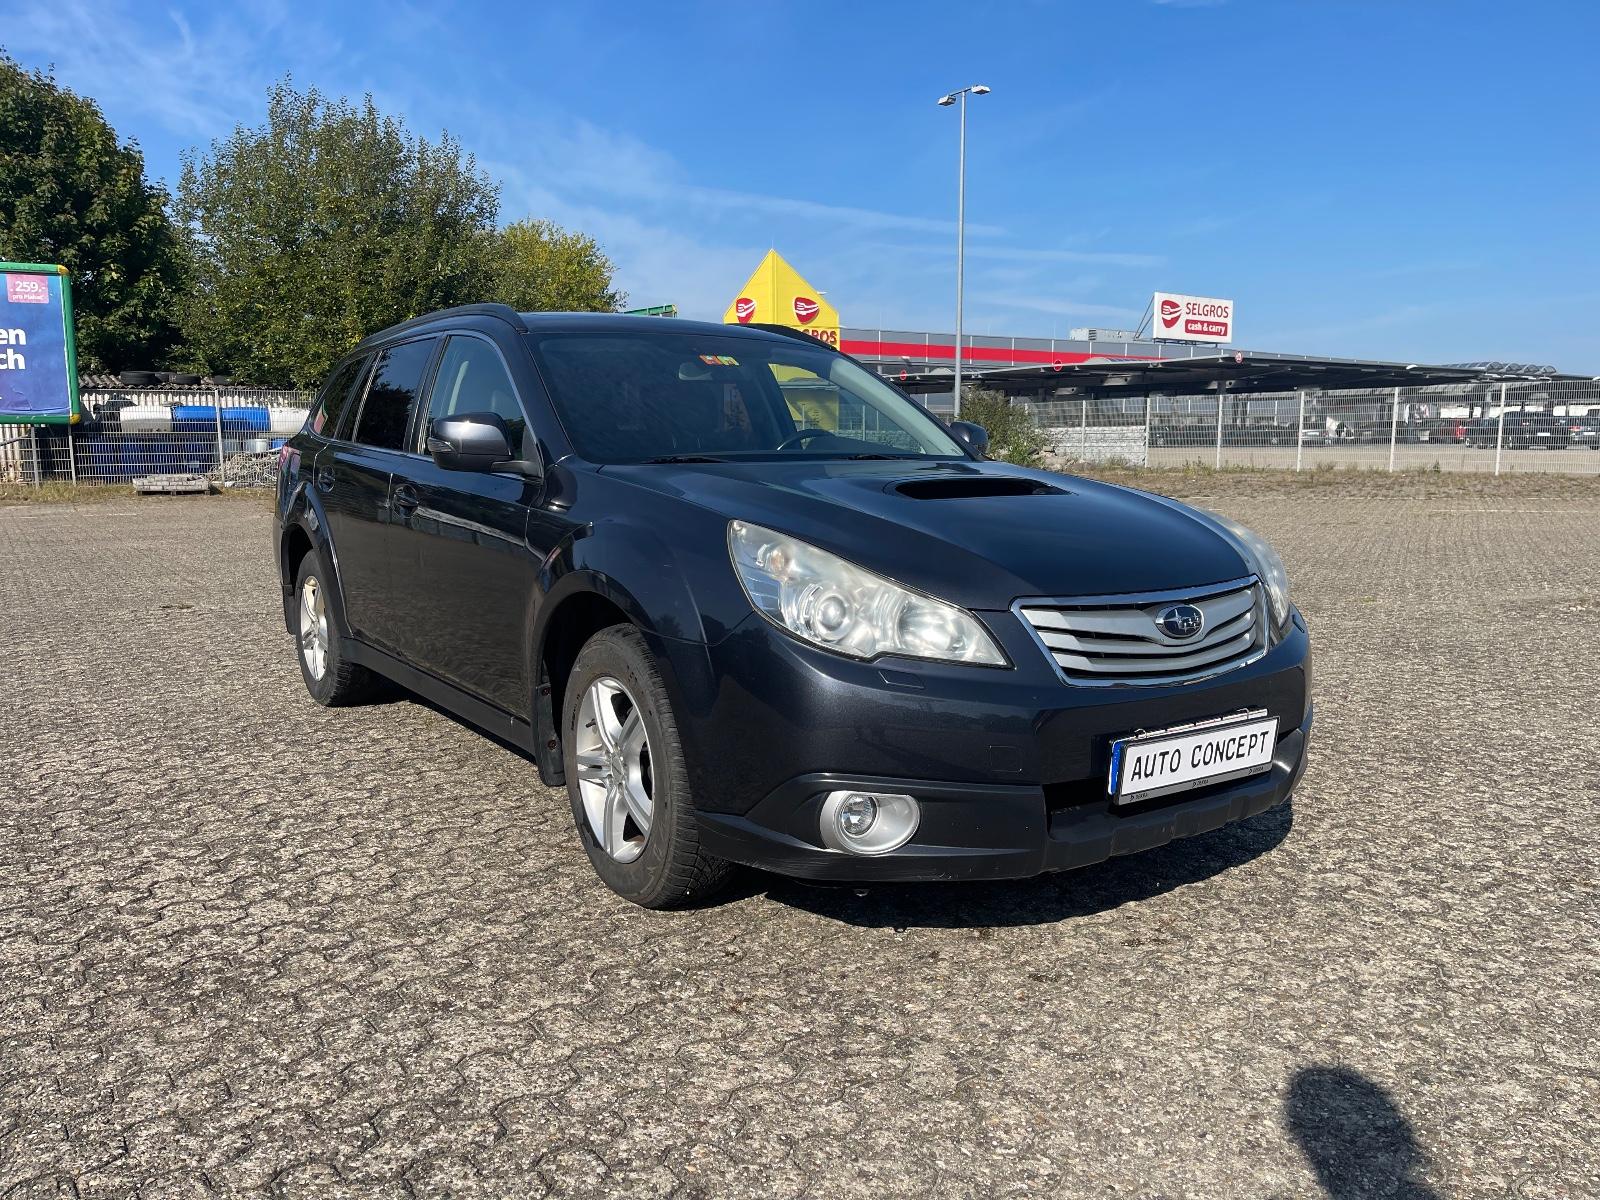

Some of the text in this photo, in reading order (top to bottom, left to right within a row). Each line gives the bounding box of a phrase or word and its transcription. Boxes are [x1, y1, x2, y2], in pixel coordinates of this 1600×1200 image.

[1185, 302, 1229, 318] SELGROS
[1187, 322, 1226, 335] cash & carry
[1130, 731, 1269, 781] AUTO CONCEPT
